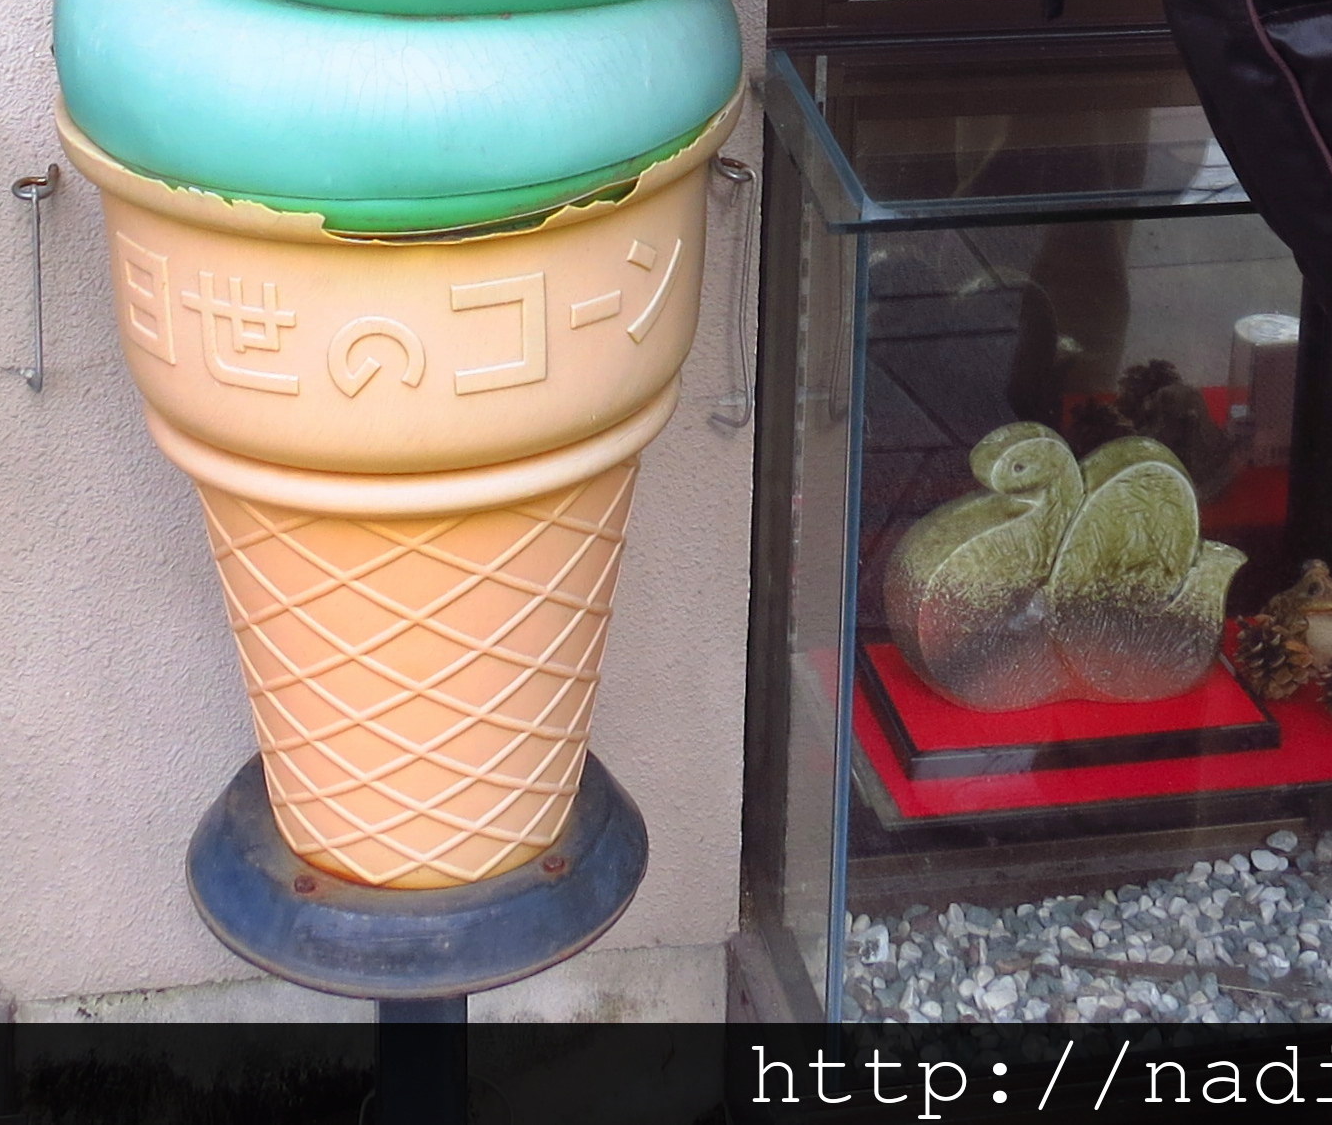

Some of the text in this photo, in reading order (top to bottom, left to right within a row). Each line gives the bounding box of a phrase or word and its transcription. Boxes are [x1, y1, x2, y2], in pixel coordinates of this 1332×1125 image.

[116, 230, 682, 397] 日世のコーン
